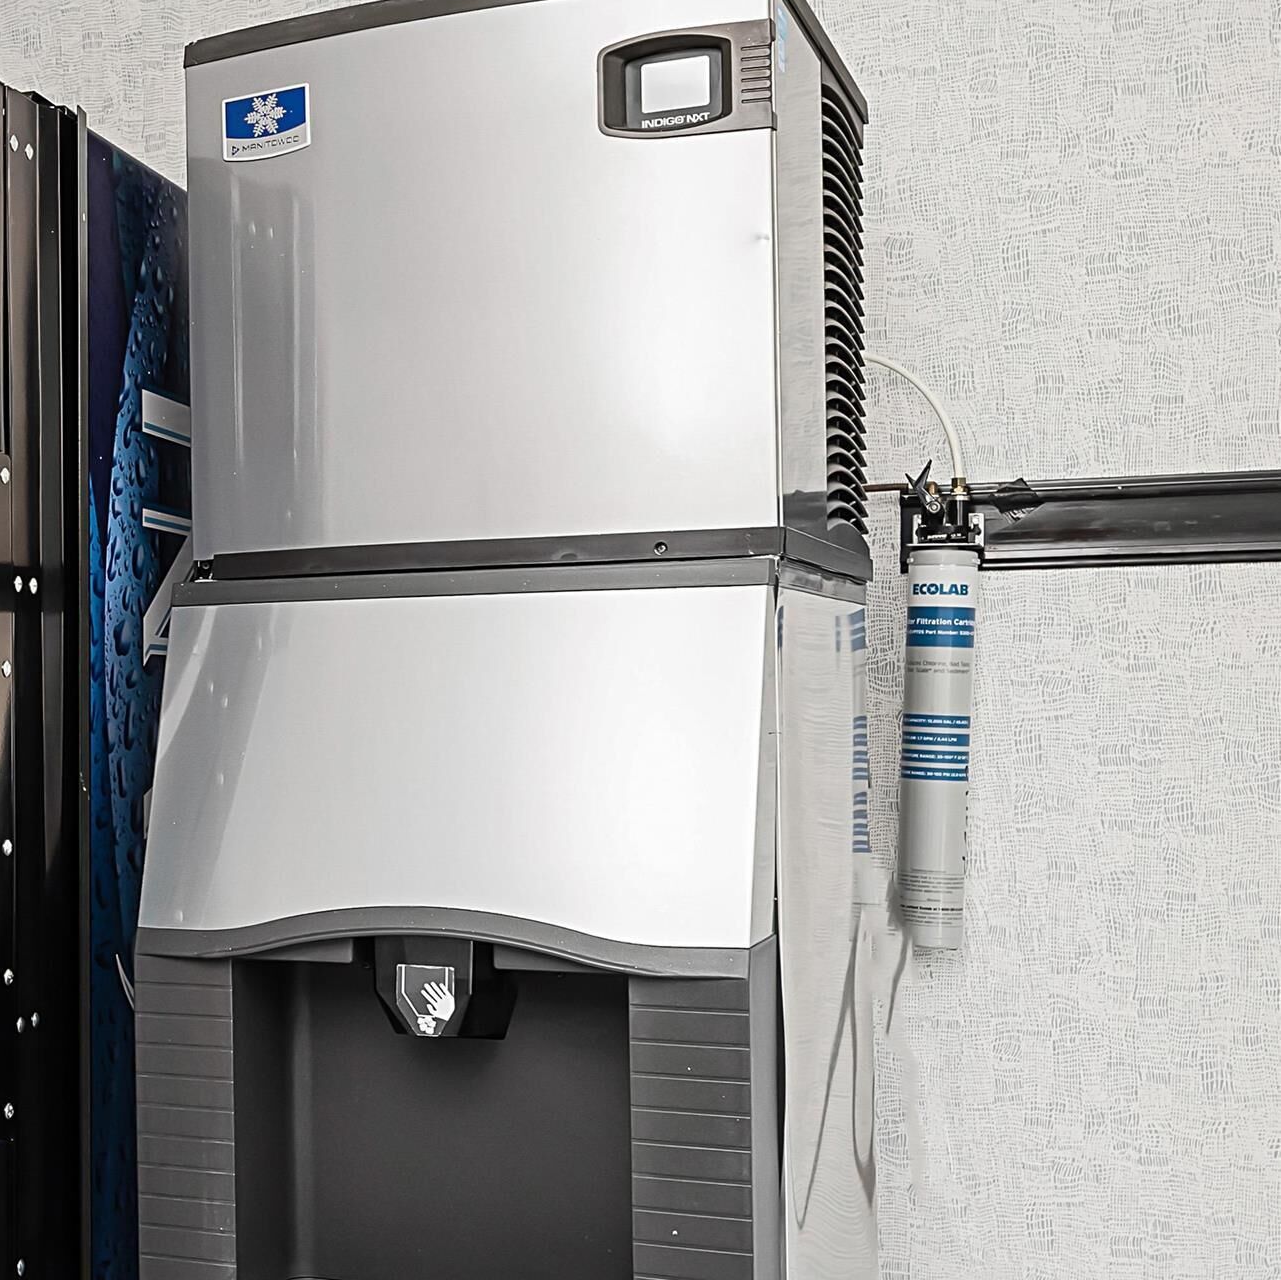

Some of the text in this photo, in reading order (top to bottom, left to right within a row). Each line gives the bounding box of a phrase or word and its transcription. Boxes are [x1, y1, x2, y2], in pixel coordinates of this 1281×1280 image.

[641, 112, 711, 129] INDIGO NXT
[241, 135, 300, 153] MANITOWOC
[912, 583, 969, 595] ECOLAB
